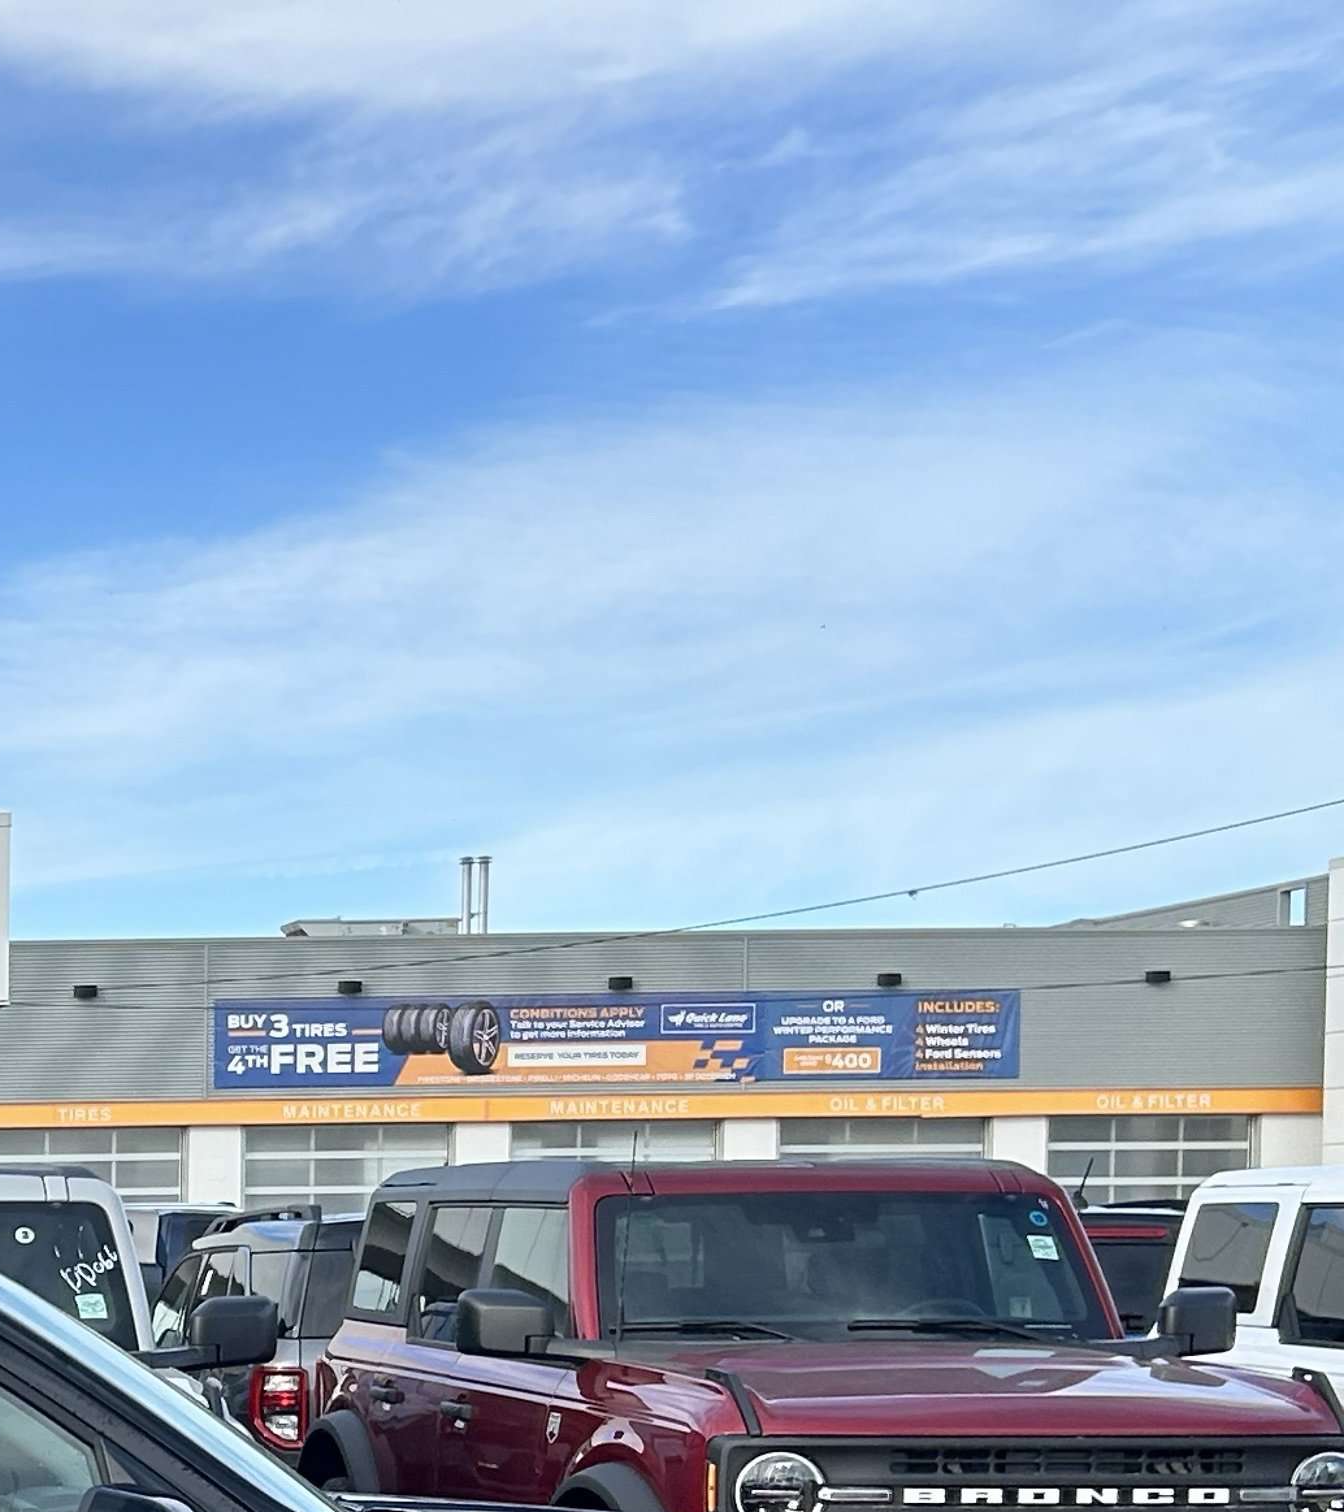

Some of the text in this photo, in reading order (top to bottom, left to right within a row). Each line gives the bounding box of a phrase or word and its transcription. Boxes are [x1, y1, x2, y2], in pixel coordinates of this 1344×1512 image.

[510, 1007, 646, 1019] CONDITIONS APPLY
[822, 1001, 845, 1013] OR
[918, 1001, 1000, 1013] INCLUDES:
[686, 1012, 748, 1024] Quick Lane
[780, 1016, 885, 1025] UPGRADE TO A FORD
[227, 1014, 347, 1038] BUY 3 TIRES
[510, 1019, 645, 1030] Talk to your Service Advisor
[773, 1025, 893, 1035] WINTER PERFORMANCE
[915, 1023, 996, 1034] 4 Winter Tires
[511, 1029, 626, 1040] to get more information
[808, 1035, 857, 1043] PACKAGE
[925, 1036, 969, 1047] Wheels
[270, 1043, 379, 1074] FREE
[609, 1051, 640, 1059] TODAY
[925, 1048, 953, 1059] Ford
[953, 1048, 1002, 1059] Sensors
[227, 1055, 269, 1075] 4TH
[825, 1053, 872, 1068] $400
[549, 1099, 690, 1115] MAINTENANCE
[830, 1096, 945, 1111] OIL & FILTER
[1096, 1094, 1211, 1109] OIL & FILTER
[57, 1108, 112, 1121] TIRES
[282, 1103, 422, 1119] MAINTENANCE
[903, 1487, 1230, 1504] BRONCO
